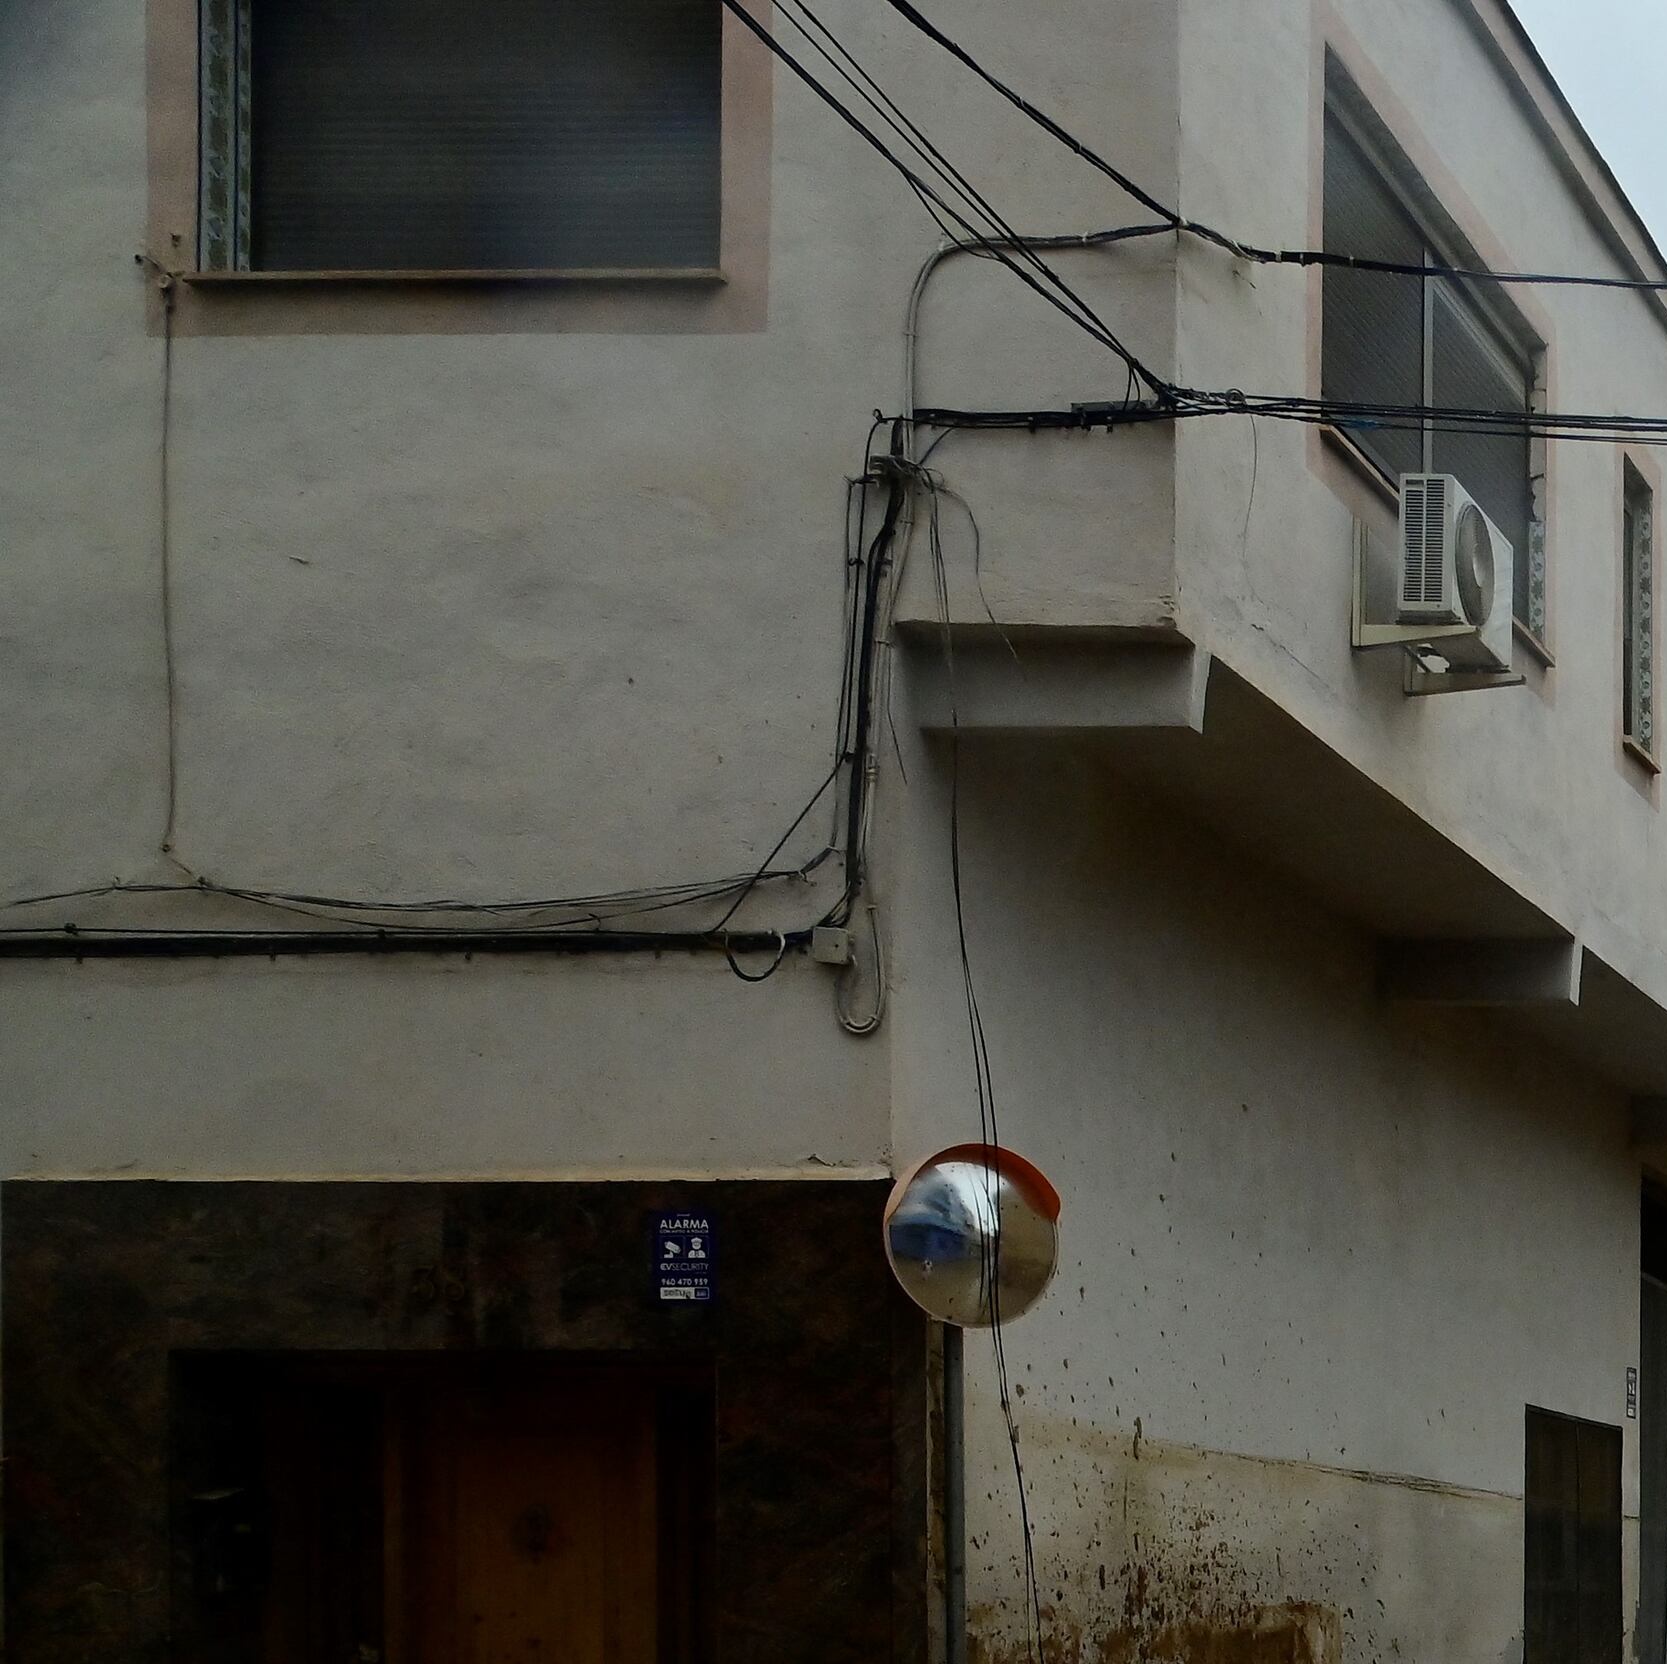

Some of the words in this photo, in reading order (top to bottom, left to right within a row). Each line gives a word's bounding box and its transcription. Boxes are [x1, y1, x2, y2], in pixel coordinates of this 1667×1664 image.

[660, 1219, 709, 1229] ALARMA
[661, 1278, 676, 1286] 960
[678, 1278, 692, 1286] 470
